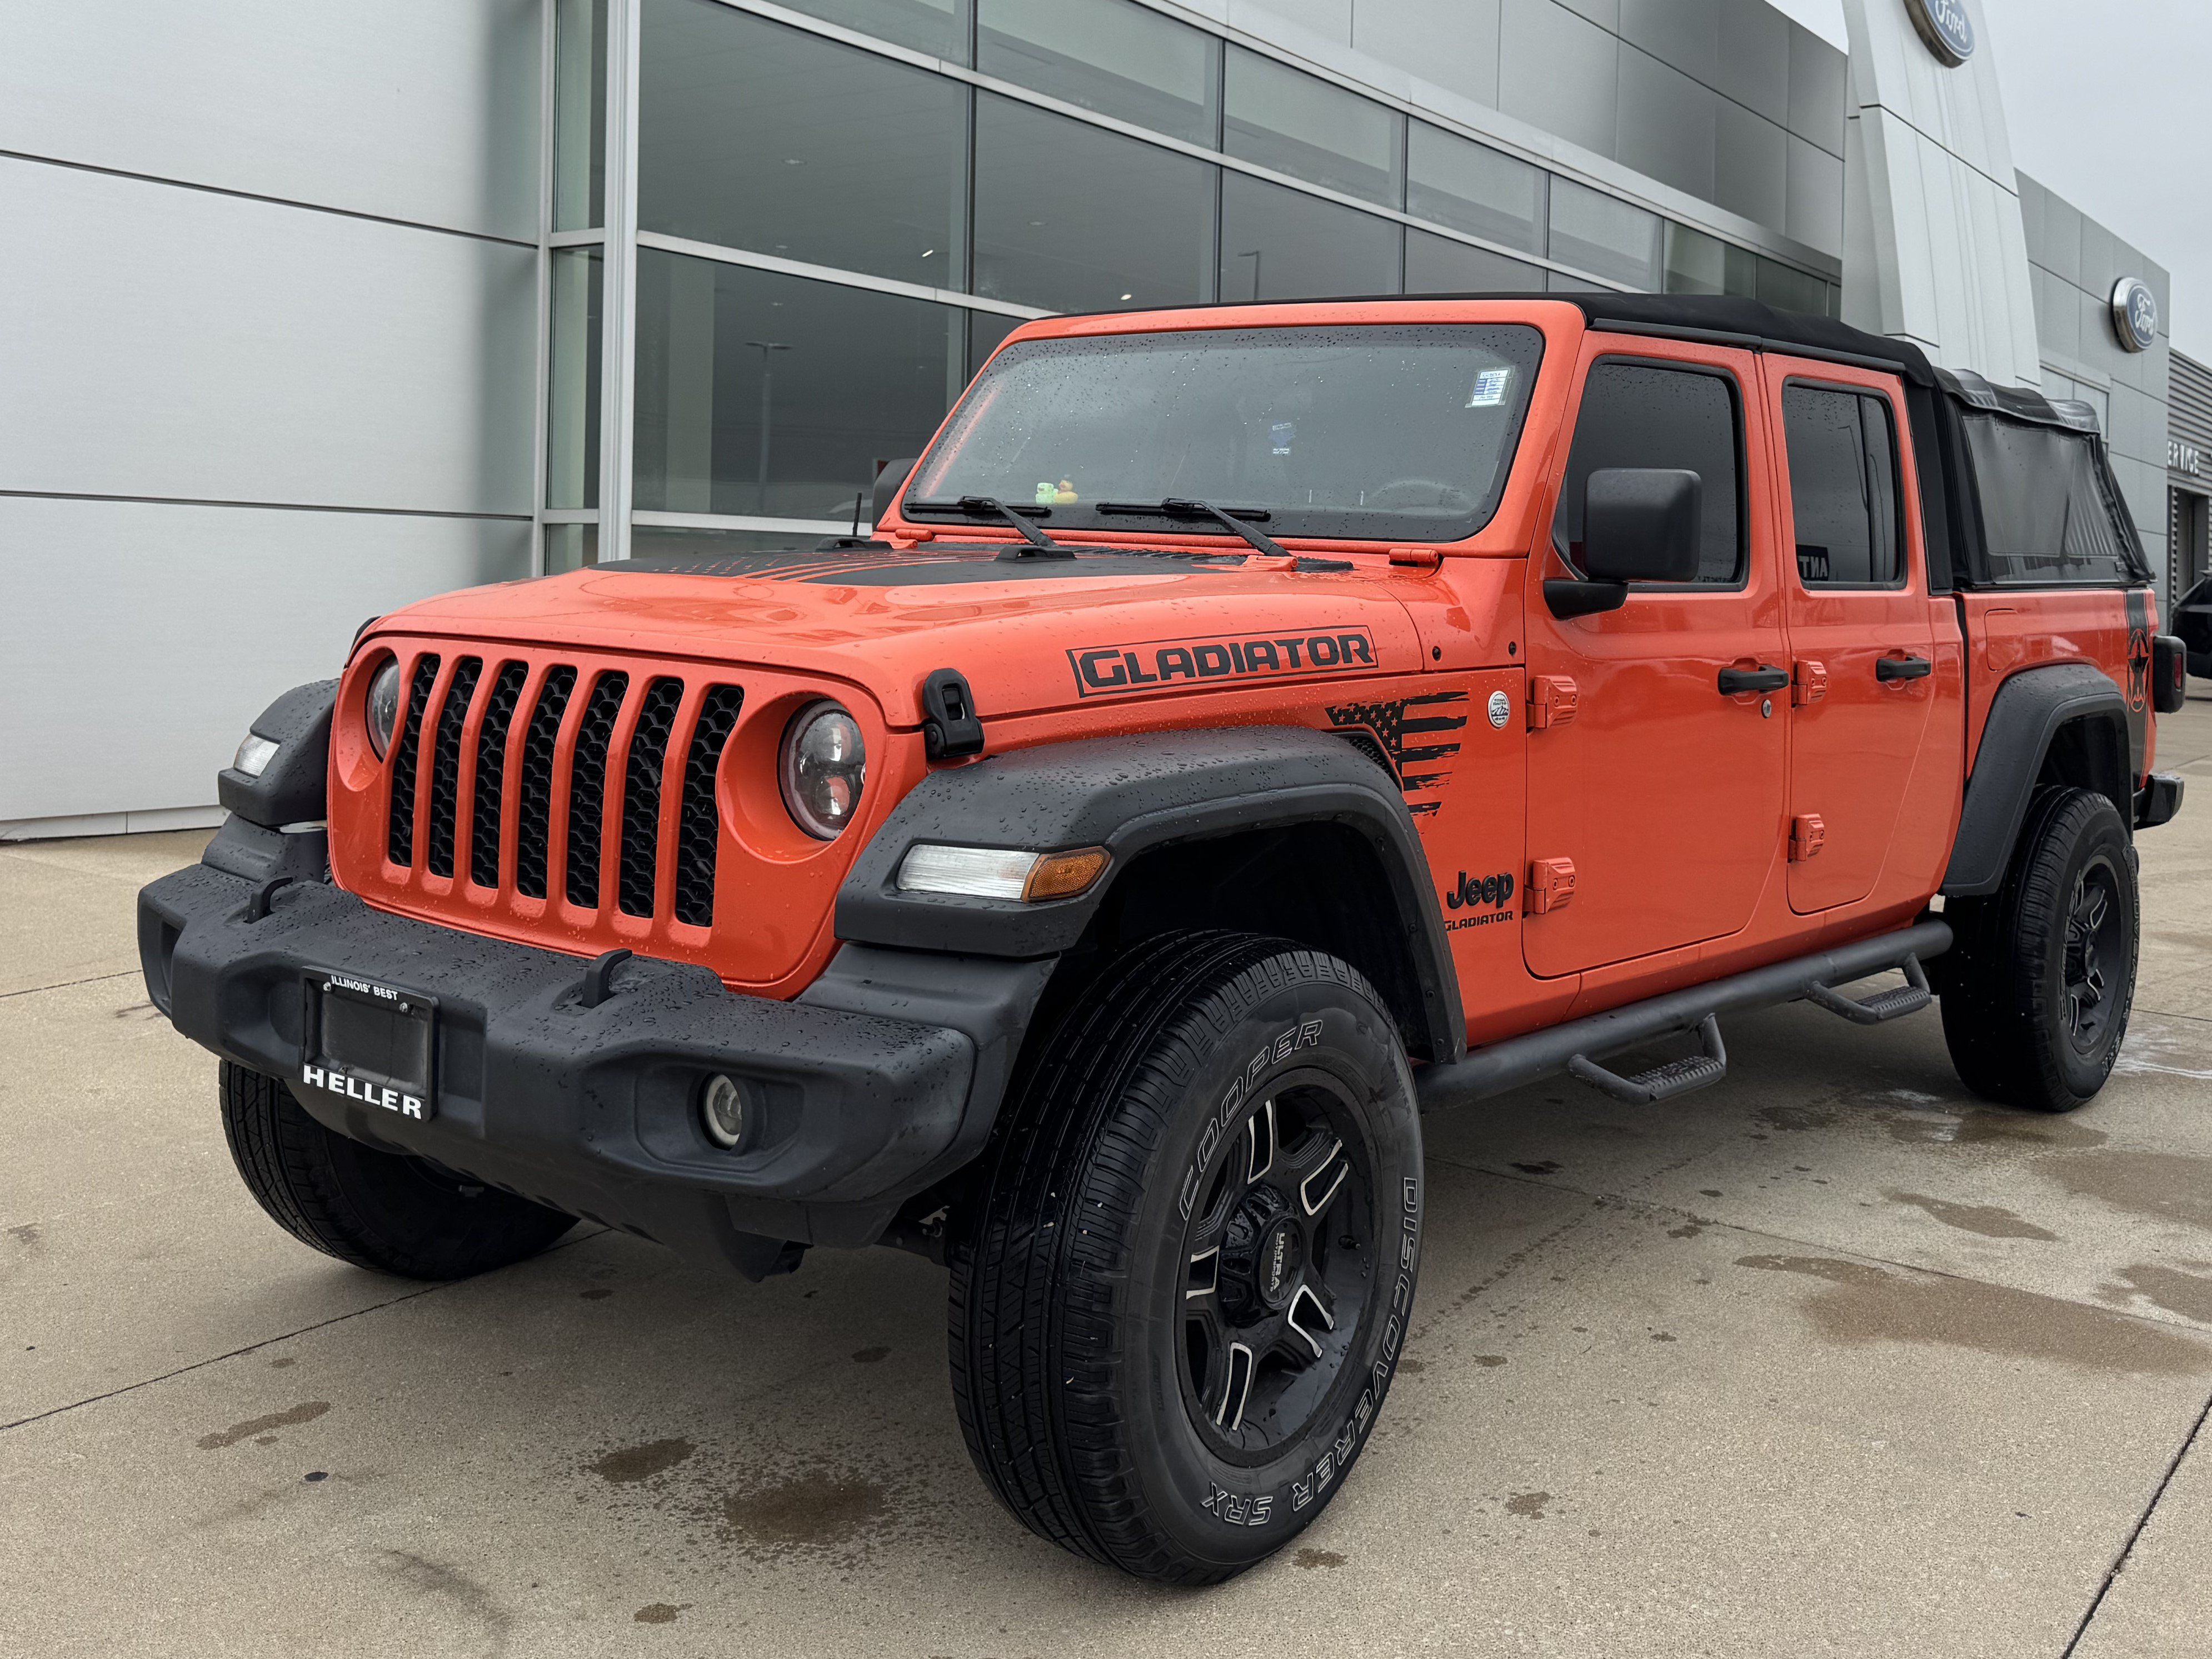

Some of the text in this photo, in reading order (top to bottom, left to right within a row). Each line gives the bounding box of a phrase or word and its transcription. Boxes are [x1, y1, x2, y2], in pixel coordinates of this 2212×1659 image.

[2135, 293, 2155, 336] Ford
[1079, 634, 1375, 688] GLADIATOR
[1446, 870, 1514, 909] Jeep
[1444, 910, 1514, 931] GLADIATOR
[331, 975, 398, 1000] ILLINOIS' BEST
[303, 1064, 422, 1119] HELLER
[1179, 1019, 1323, 1221] COOPER
[1274, 1233, 1285, 1290] ULTRA
[1200, 1177, 1417, 1526] DISCOVERER SRX
